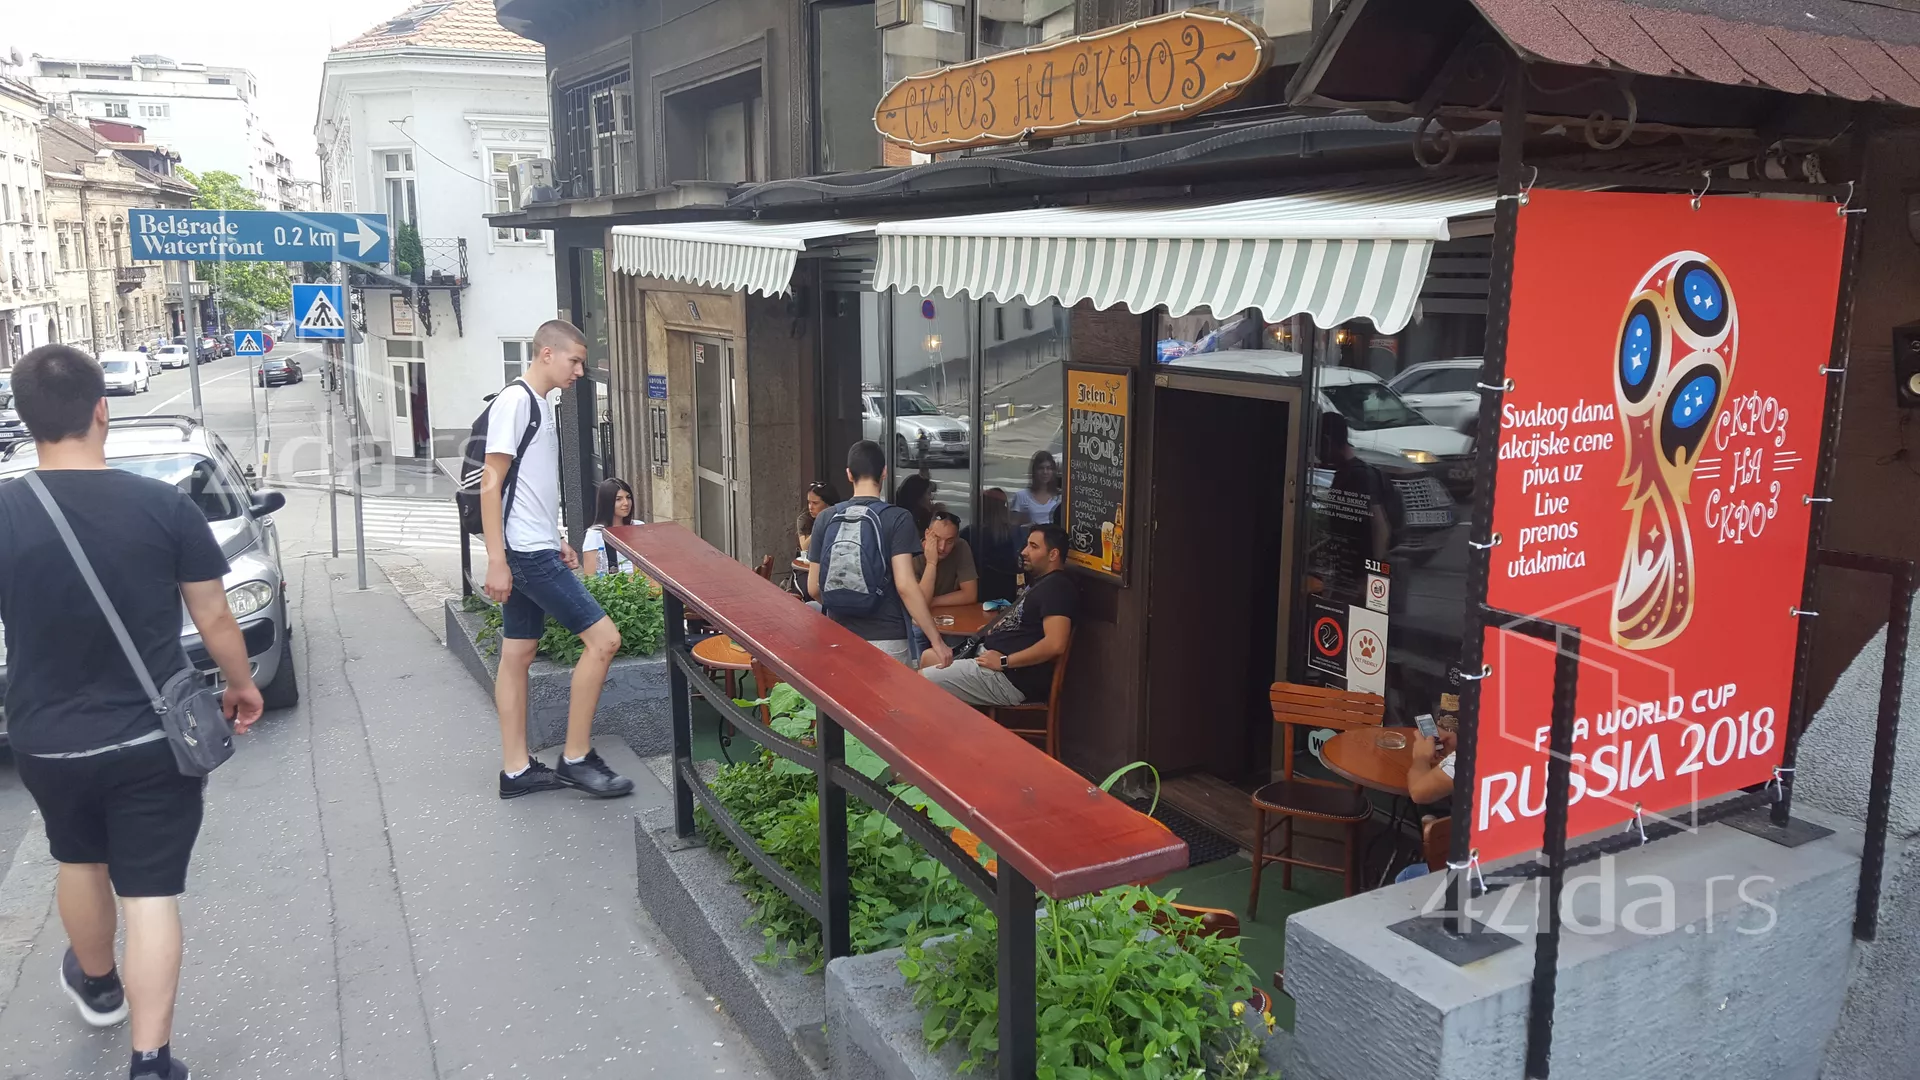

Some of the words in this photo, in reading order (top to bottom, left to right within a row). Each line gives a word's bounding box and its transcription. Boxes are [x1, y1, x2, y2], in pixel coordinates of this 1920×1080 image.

[903, 69, 996, 140] СКРОЗ
[1013, 61, 1055, 127] НА
[1069, 24, 1206, 119] СКРОЗ
[138, 214, 239, 237] Belgrade
[273, 226, 303, 247] 0.2
[309, 230, 336, 247] km
[139, 235, 265, 256] Waterfront
[1077, 383, 1106, 404] Jelen
[1071, 409, 1122, 440] HAPPY
[1501, 401, 1569, 431] Svakog
[1572, 399, 1615, 423] dana
[1715, 390, 1789, 451] СКРОЗ
[1078, 435, 1119, 467] HOUR
[1499, 431, 1570, 464] akcijske
[1573, 433, 1614, 453] cene
[1522, 462, 1560, 494] piva
[1563, 464, 1583, 482] uz
[1729, 447, 1763, 493] НА
[1534, 492, 1570, 517] Live
[1705, 480, 1781, 544] СКРОЗ
[1519, 521, 1579, 552] prenos
[1364, 559, 1381, 572] 5.11
[1507, 547, 1586, 578] utakmica
[1534, 716, 1589, 752] FA
[1596, 694, 1685, 737] WORLD
[1691, 683, 1737, 714] CUP
[1675, 706, 1776, 776] 2018
